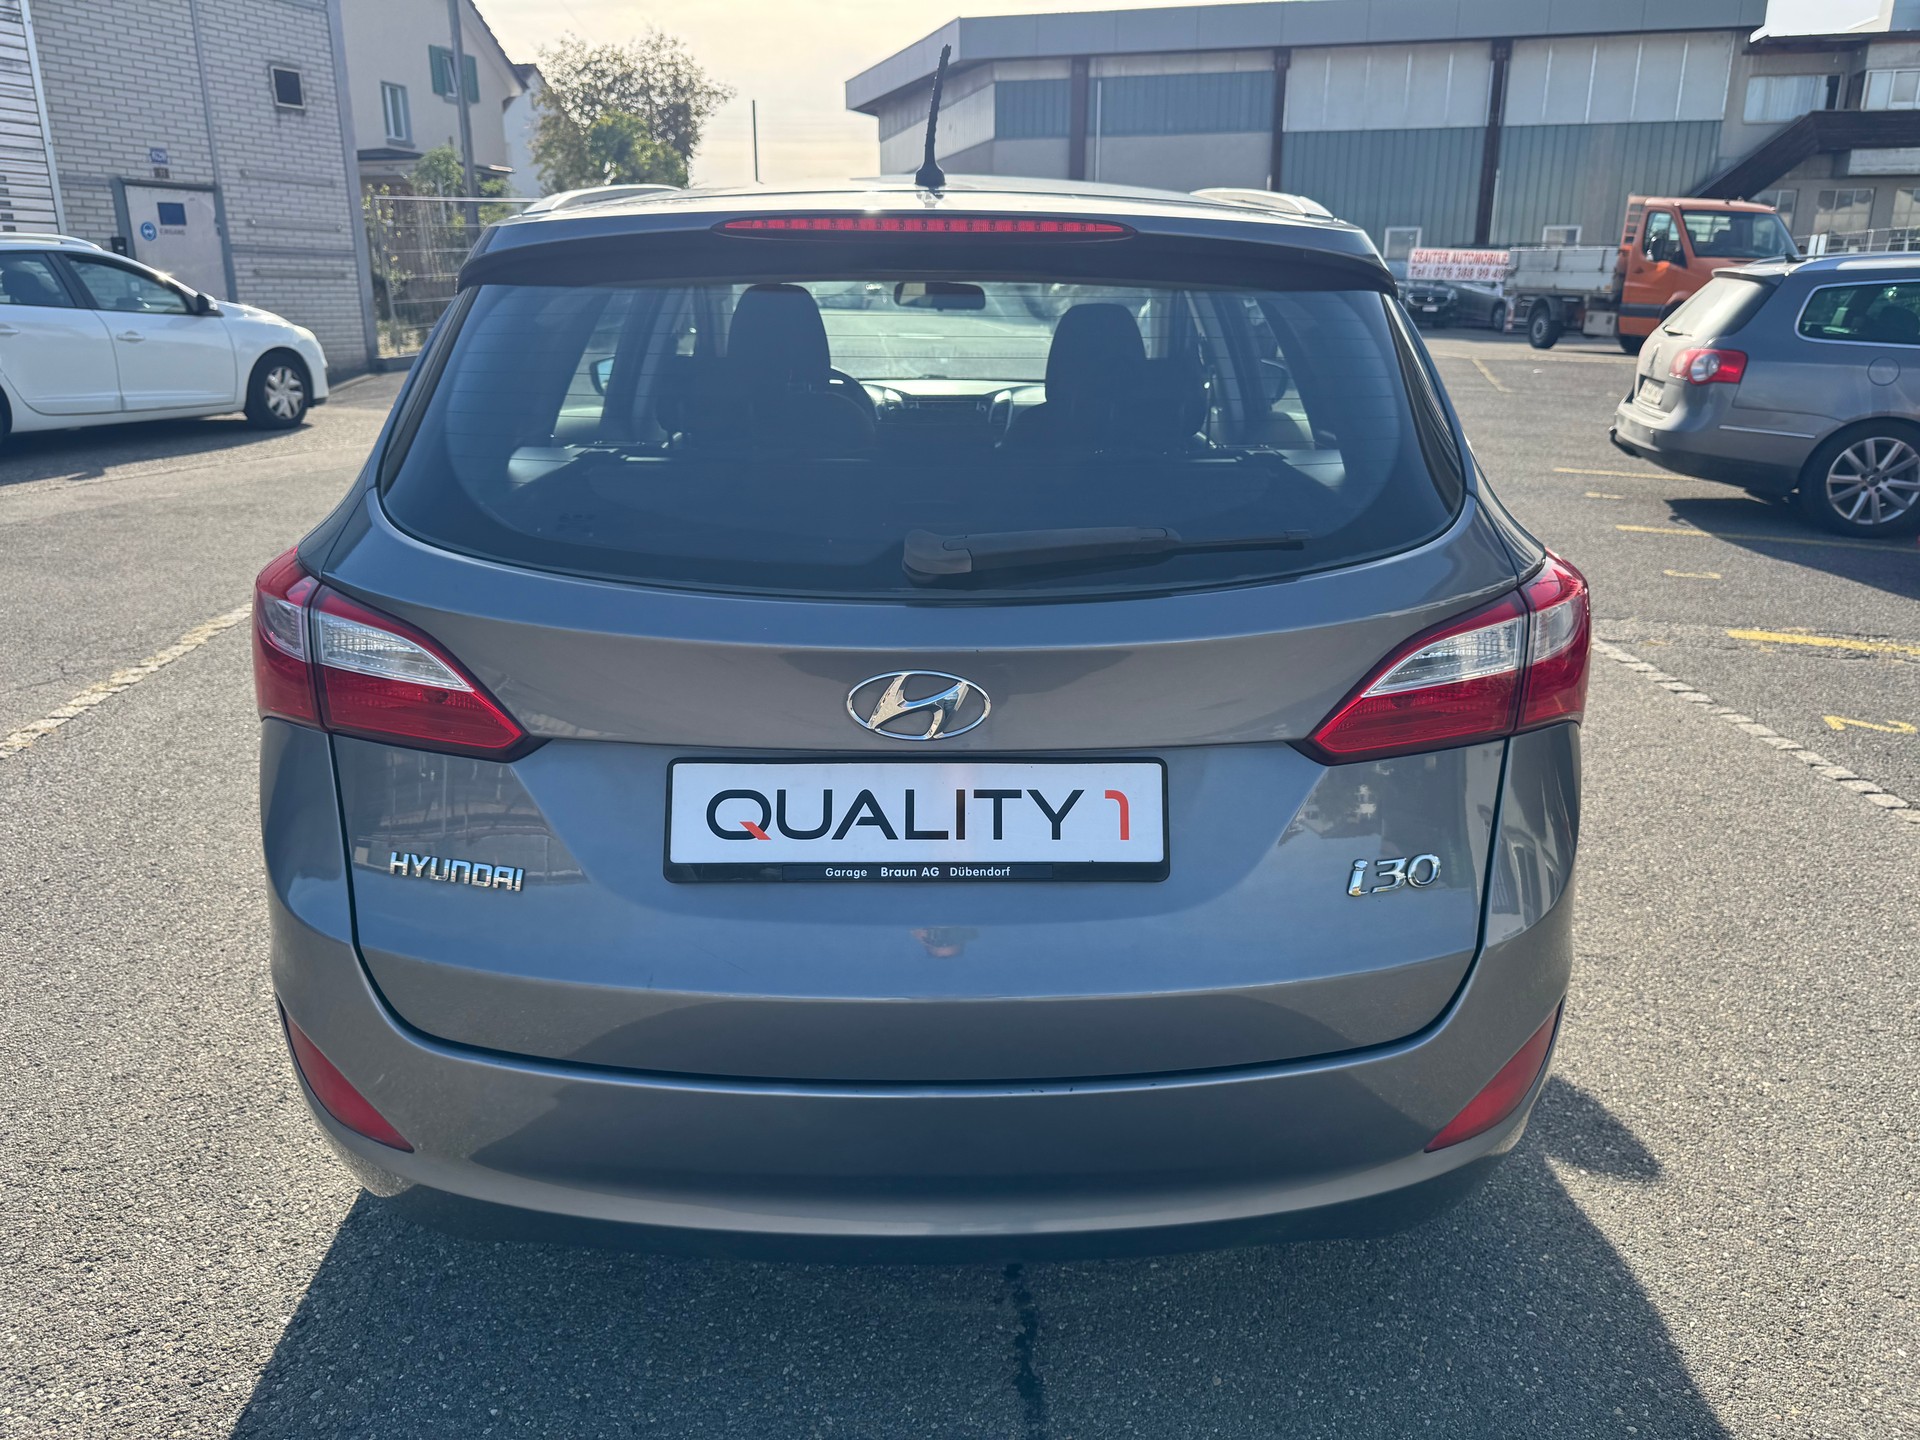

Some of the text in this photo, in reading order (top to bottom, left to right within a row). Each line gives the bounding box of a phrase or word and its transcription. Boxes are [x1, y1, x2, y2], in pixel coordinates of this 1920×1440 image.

[706, 788, 1130, 841] QUALITY 1
[389, 851, 524, 892] HYUNDAI
[825, 866, 1011, 879] Garage Braun AG Dübendorf
[1347, 853, 1442, 897] i30
